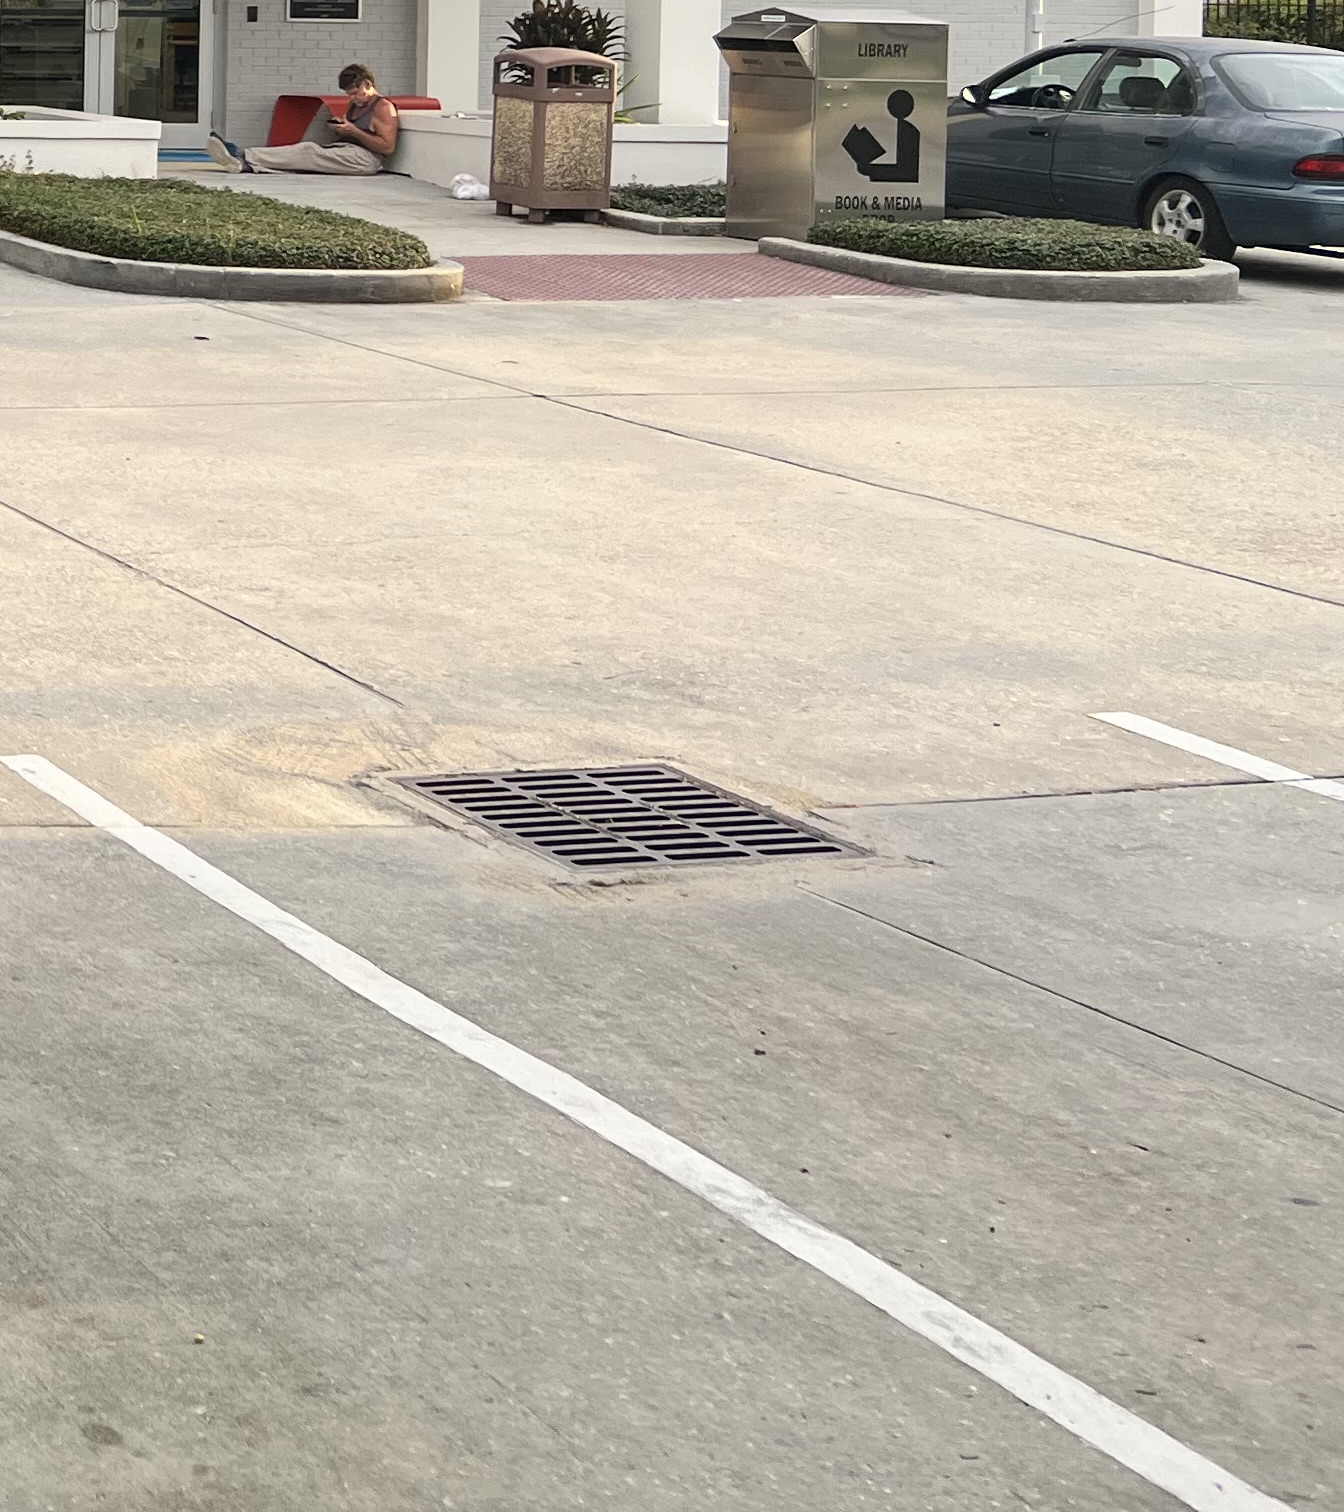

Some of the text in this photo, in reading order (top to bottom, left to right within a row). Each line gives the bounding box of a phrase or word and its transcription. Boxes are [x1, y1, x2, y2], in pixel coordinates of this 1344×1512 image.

[857, 43, 909, 58] LIBRARY
[834, 195, 923, 211] BOOK & MEDIA
